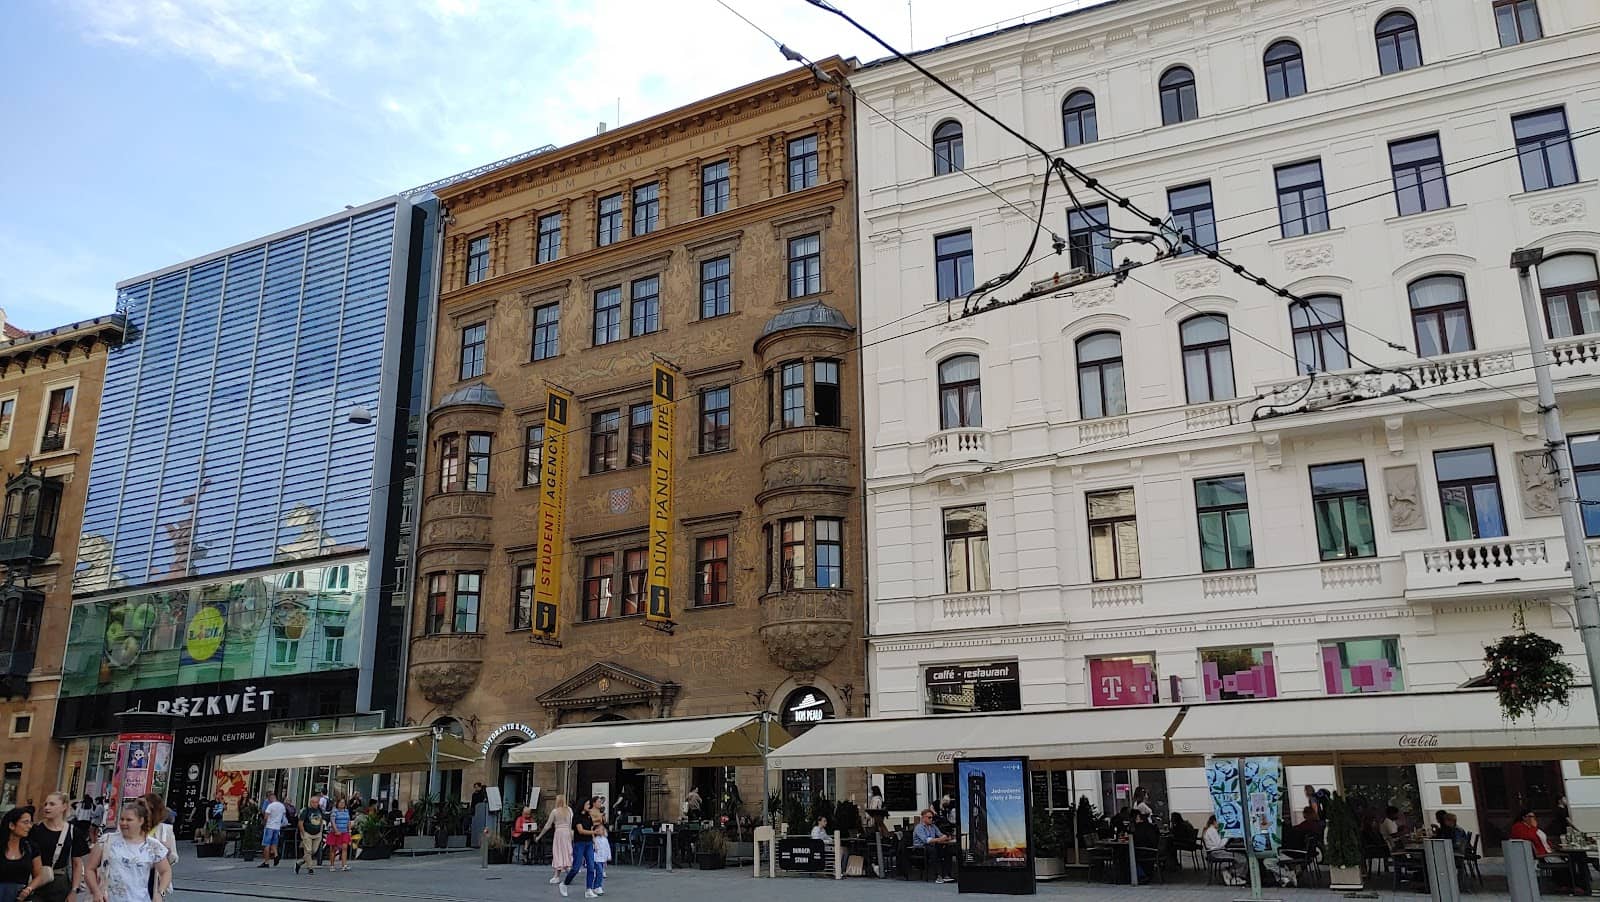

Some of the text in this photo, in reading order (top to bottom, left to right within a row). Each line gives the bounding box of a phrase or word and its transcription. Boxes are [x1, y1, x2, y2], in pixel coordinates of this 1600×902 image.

[657, 449, 668, 461] Z
[655, 467, 668, 520] PÁNŮ
[541, 434, 558, 586] STUDENT AGENCY
[653, 530, 667, 578] DŮM
[933, 669, 955, 680] caffé
[963, 666, 1009, 679] restaurant
[795, 710, 806, 721] DON
[221, 731, 256, 741] CENTRUM
